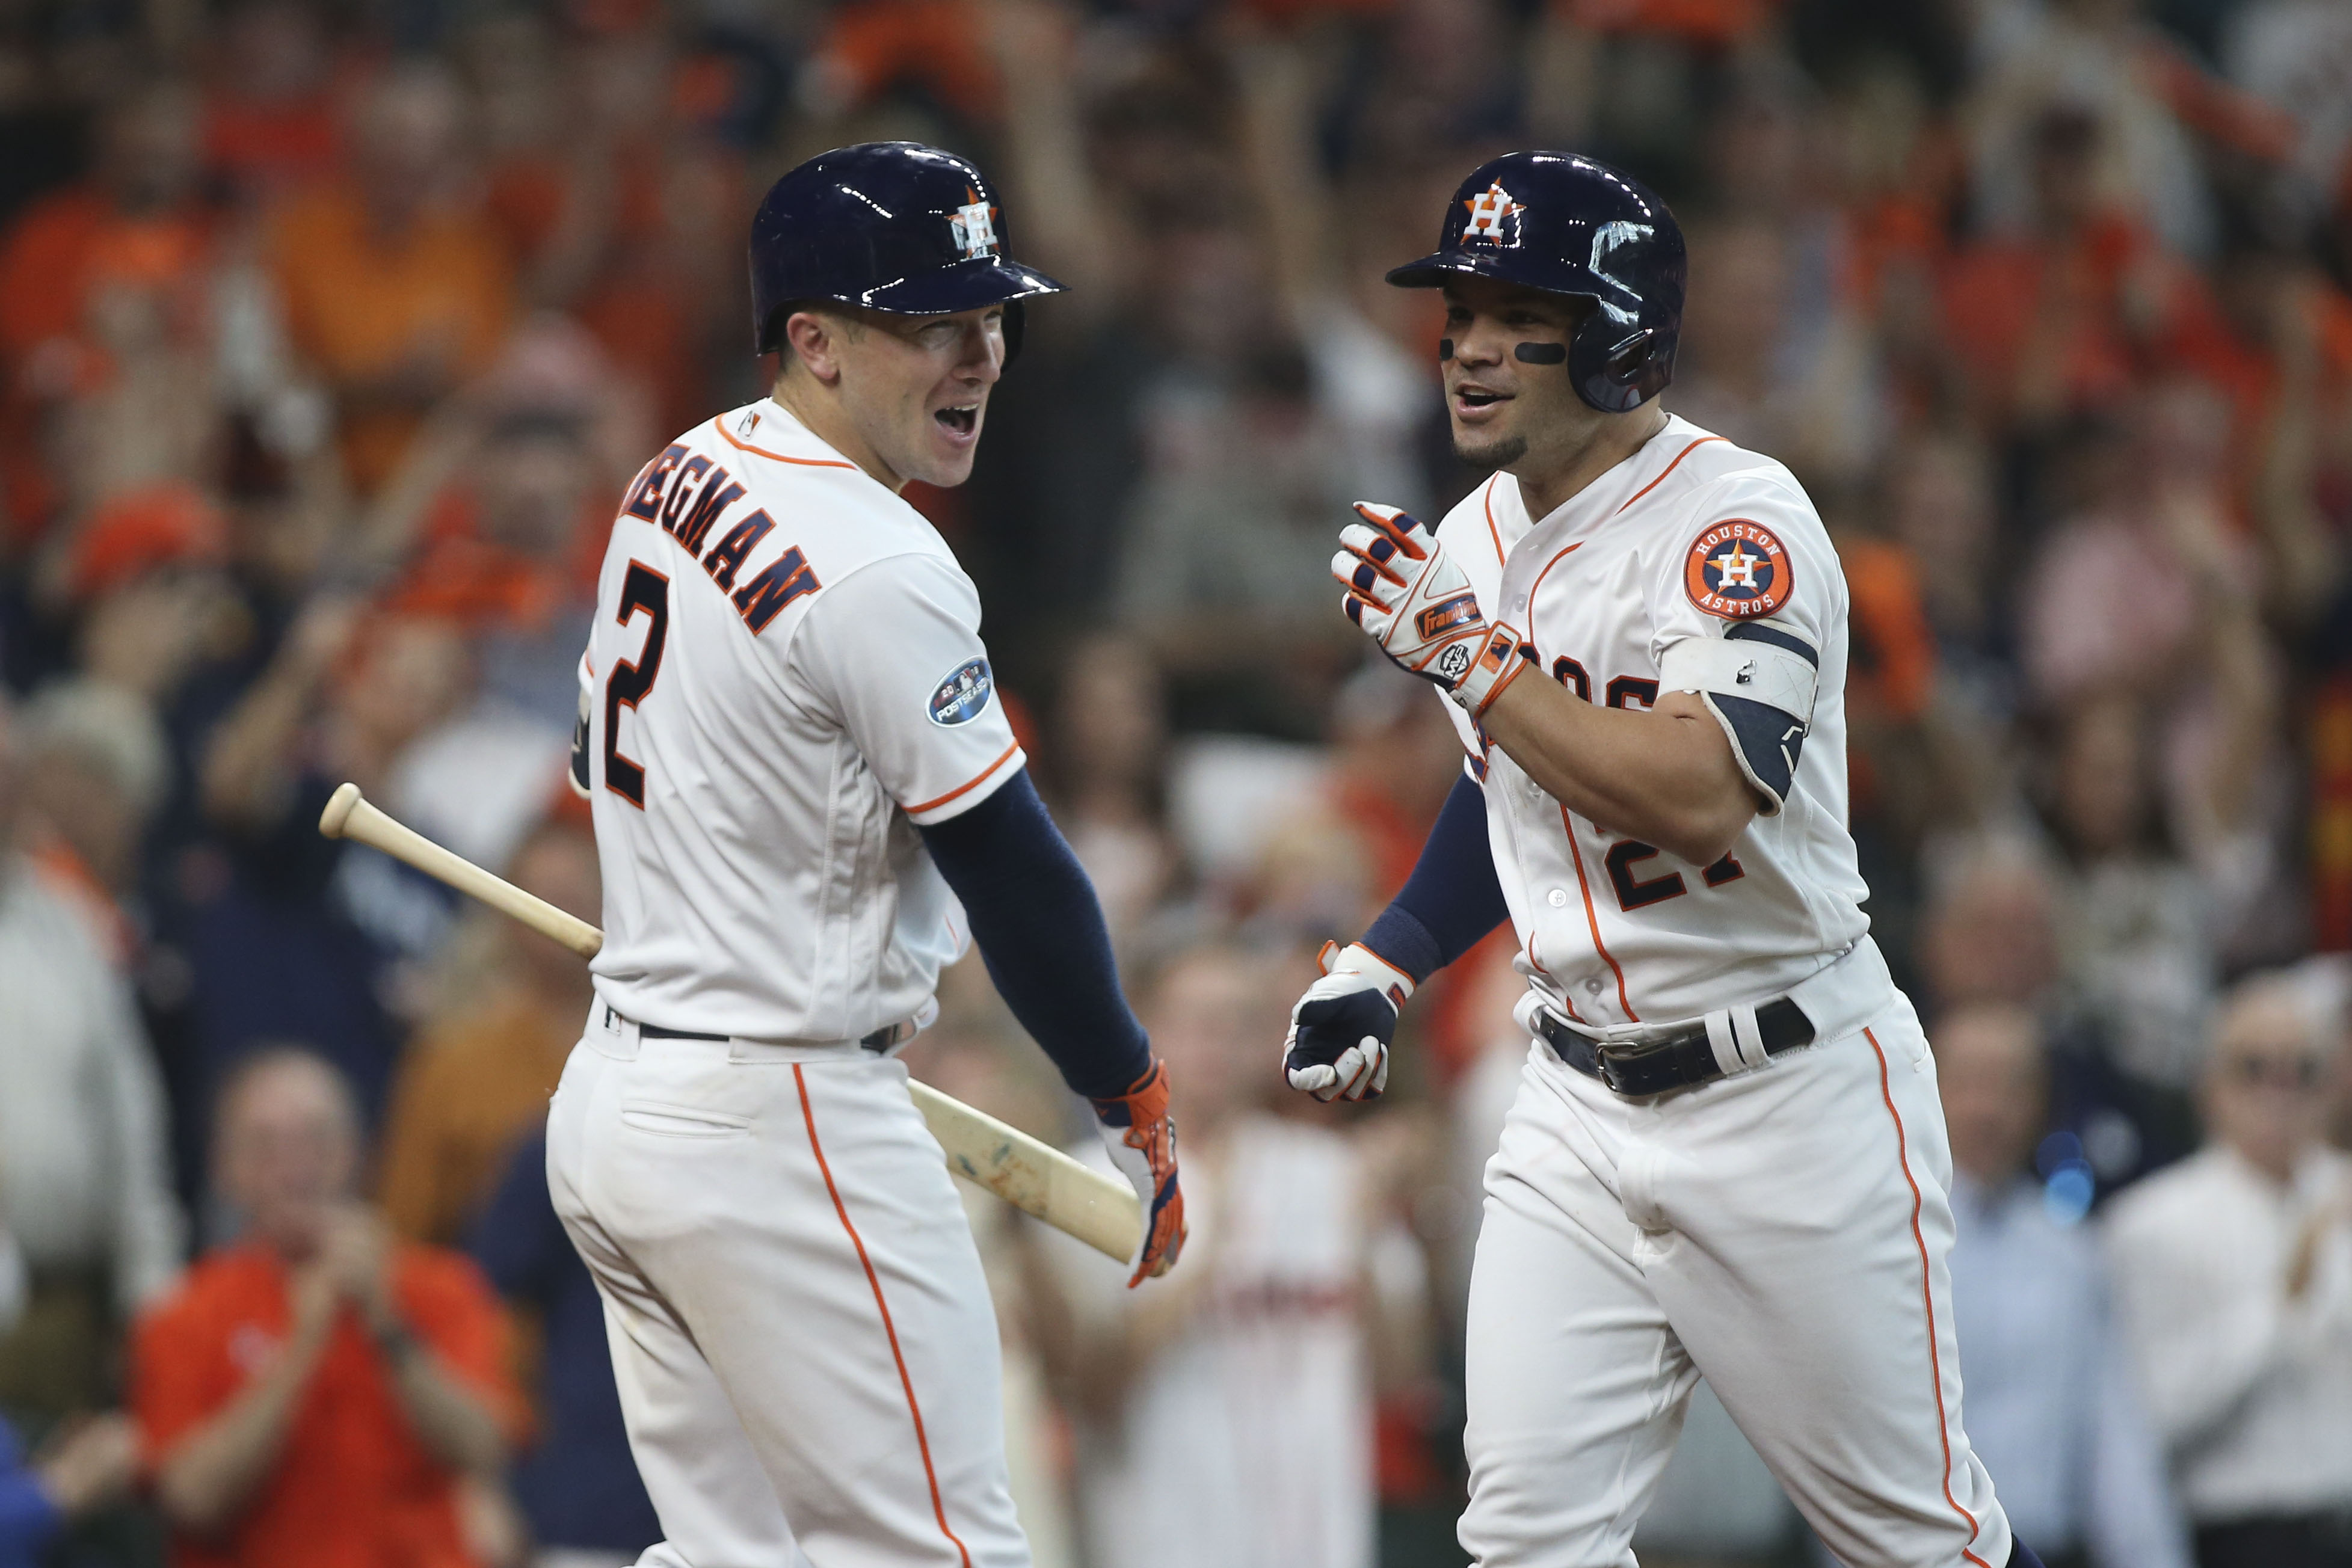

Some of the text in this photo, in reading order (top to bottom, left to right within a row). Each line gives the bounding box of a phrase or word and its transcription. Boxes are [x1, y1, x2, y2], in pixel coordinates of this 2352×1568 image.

[1464, 192, 1512, 237] H
[616, 442, 822, 636] EGMAN
[1696, 524, 1781, 556] HOUSTON
[1718, 553, 1759, 587] H
[1700, 592, 1775, 615] ASTROS
[1444, 644, 1467, 678] MVP
[605, 558, 670, 812] 2
[936, 677, 990, 722] POSTSEASO
[941, 684, 955, 698] 20
